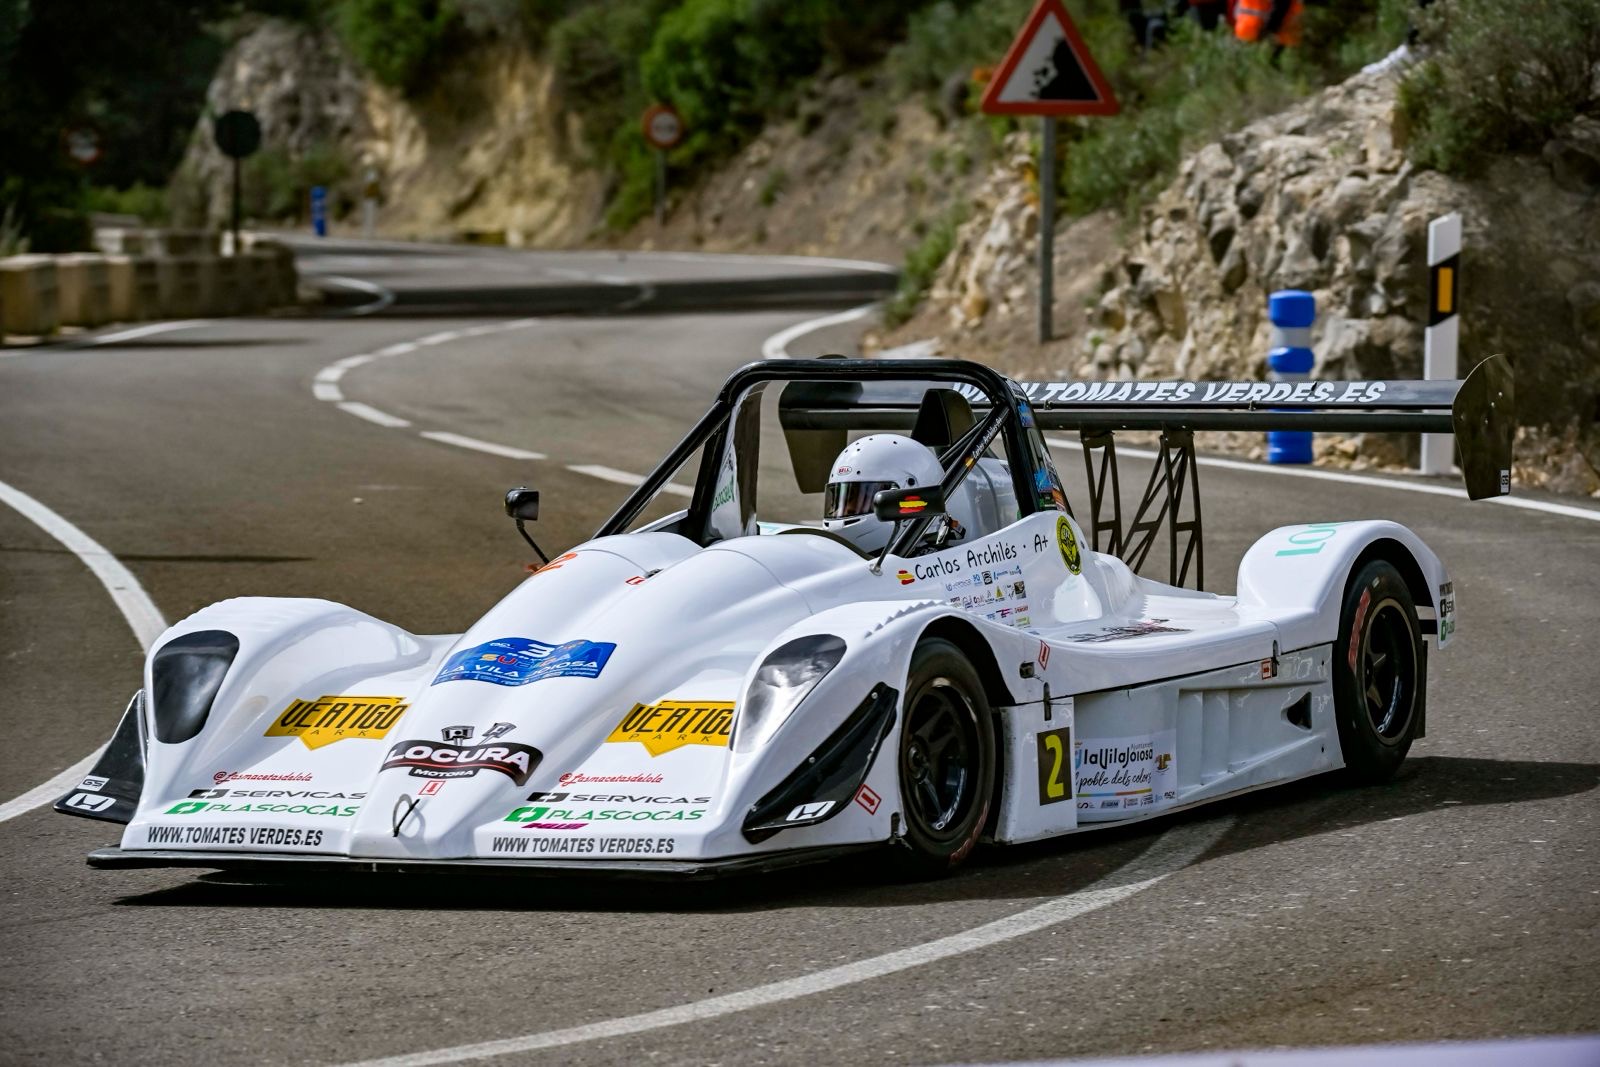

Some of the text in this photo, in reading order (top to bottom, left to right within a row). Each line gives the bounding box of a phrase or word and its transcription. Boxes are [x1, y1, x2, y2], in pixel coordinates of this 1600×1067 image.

[1200, 382, 1386, 403] VERDES.ES
[914, 557, 961, 580] Carlos
[966, 541, 1017, 568] Archilés
[1034, 533, 1049, 553] A+
[281, 702, 408, 730] VERTIGO
[287, 728, 369, 737] PARK
[628, 733, 712, 743] PARK
[385, 746, 531, 775] LOCURA
[1045, 734, 1065, 798] 2
[413, 768, 474, 777] MOTORA
[82, 778, 105, 788] GS
[229, 790, 368, 800] SERVICAS
[569, 794, 712, 804] SERVICAS
[147, 825, 324, 847] WWW.TOMATES VERDES.ES
[532, 837, 595, 853] TOMATES
[600, 837, 675, 853] VERDES.ES
